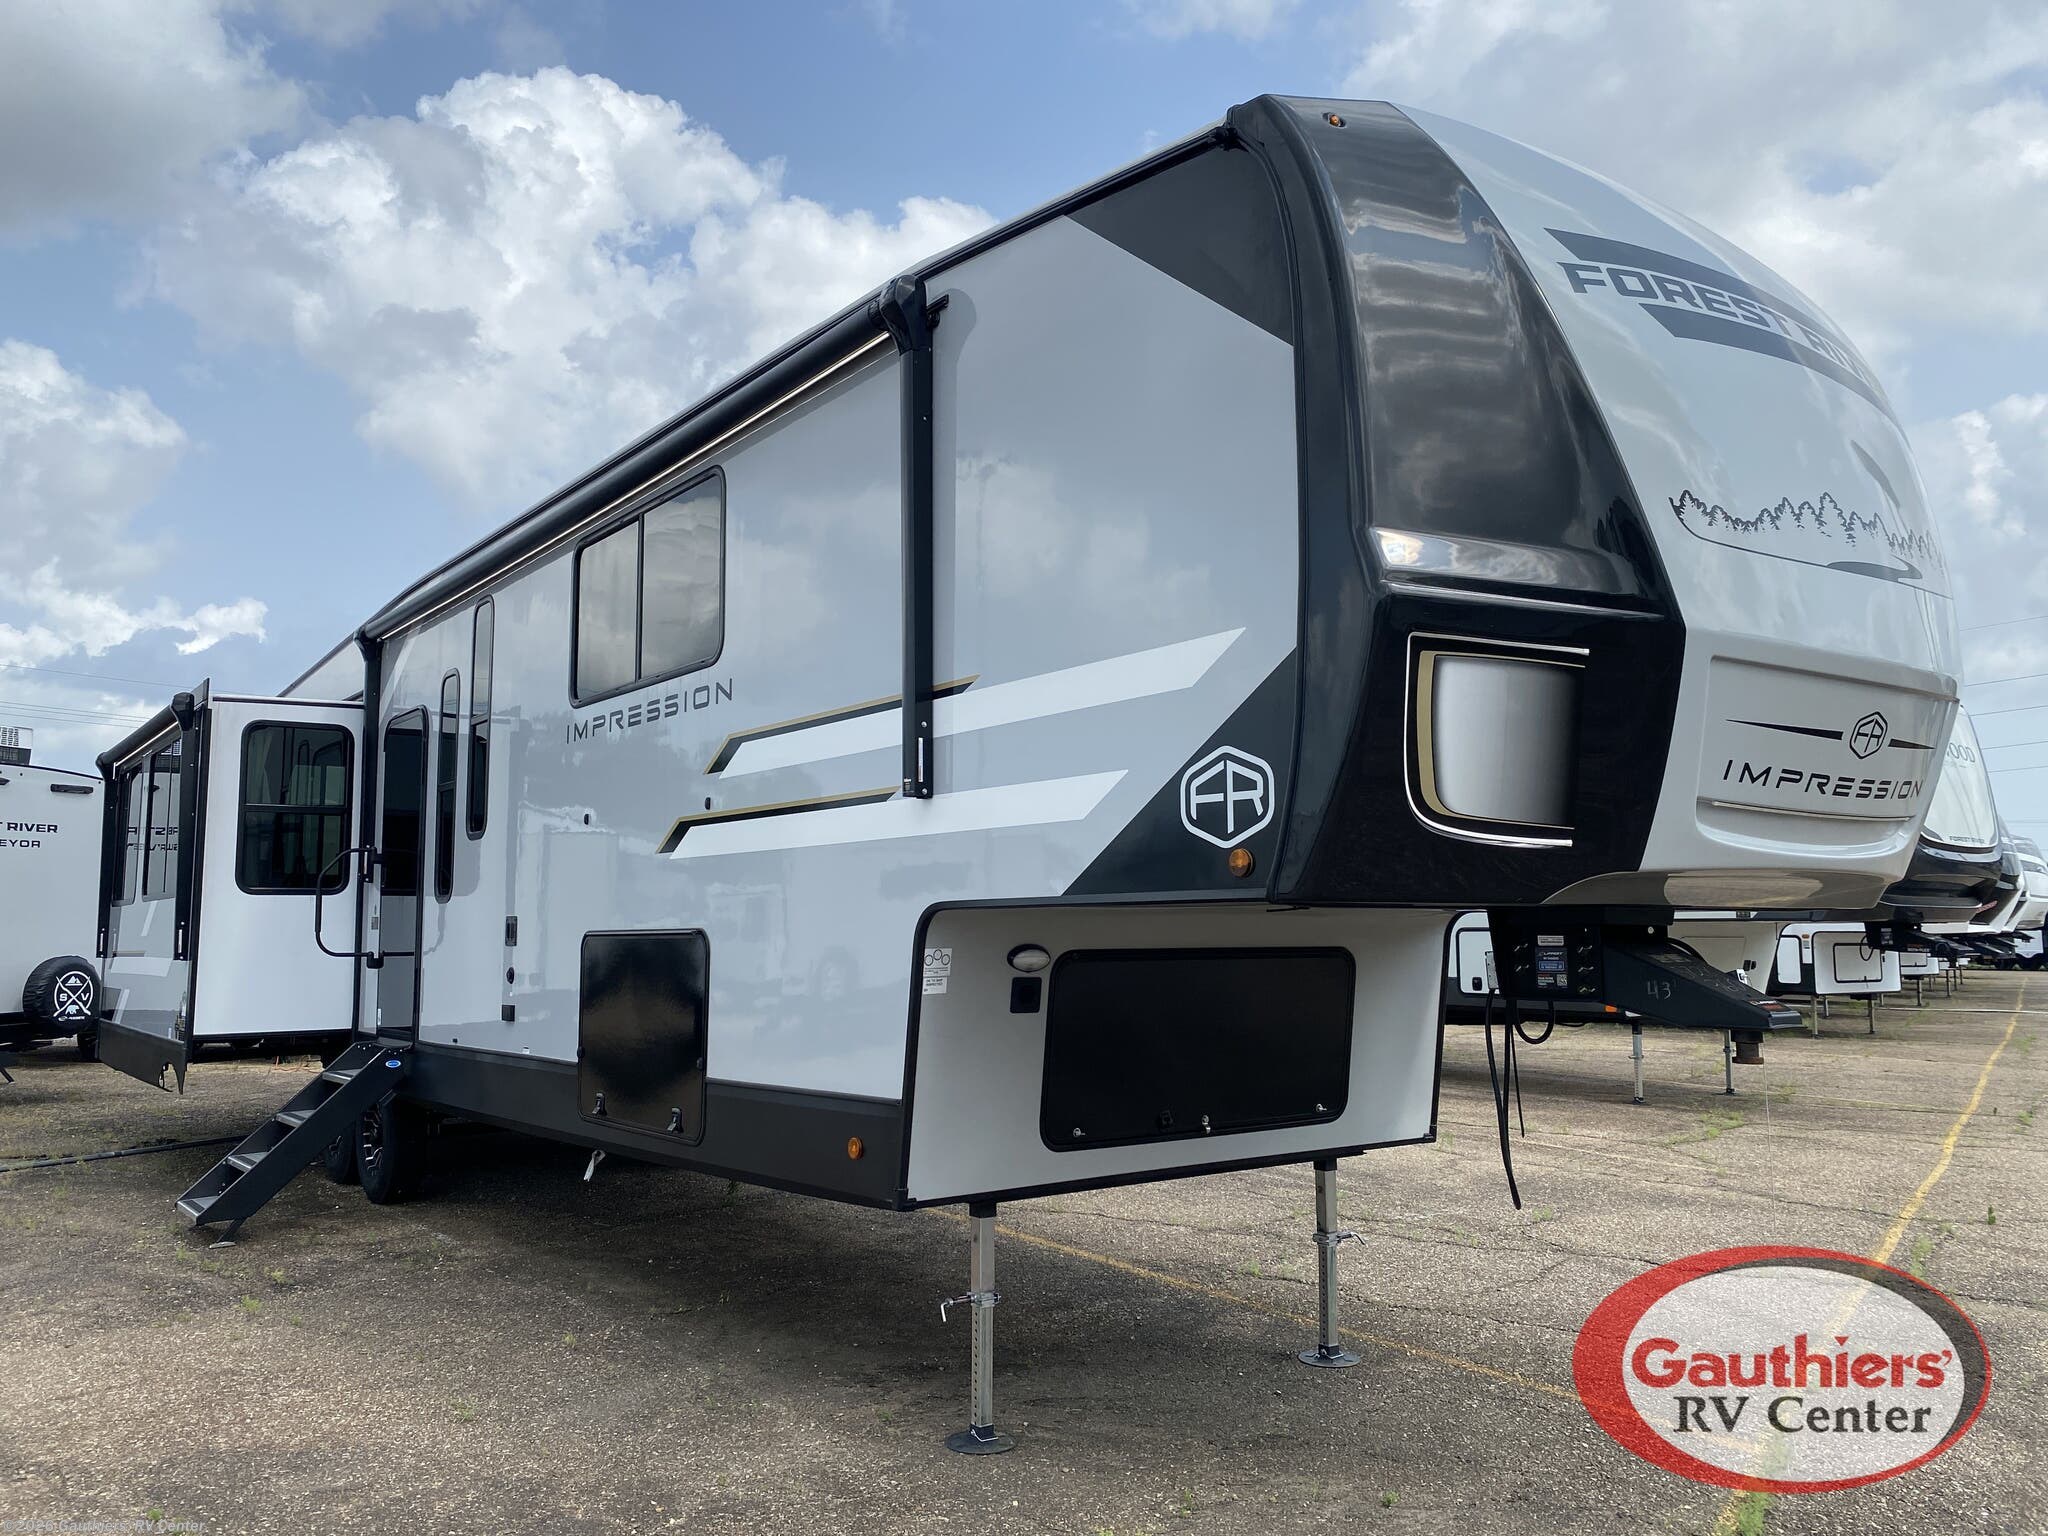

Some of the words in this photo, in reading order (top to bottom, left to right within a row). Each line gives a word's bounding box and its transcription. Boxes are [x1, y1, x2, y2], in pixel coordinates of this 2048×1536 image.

[1556, 261, 1793, 337] FOREST
[566, 678, 734, 744] IMPRESSION
[1722, 759, 1925, 800] IMPRESSION
[7, 821, 58, 833] RIVER
